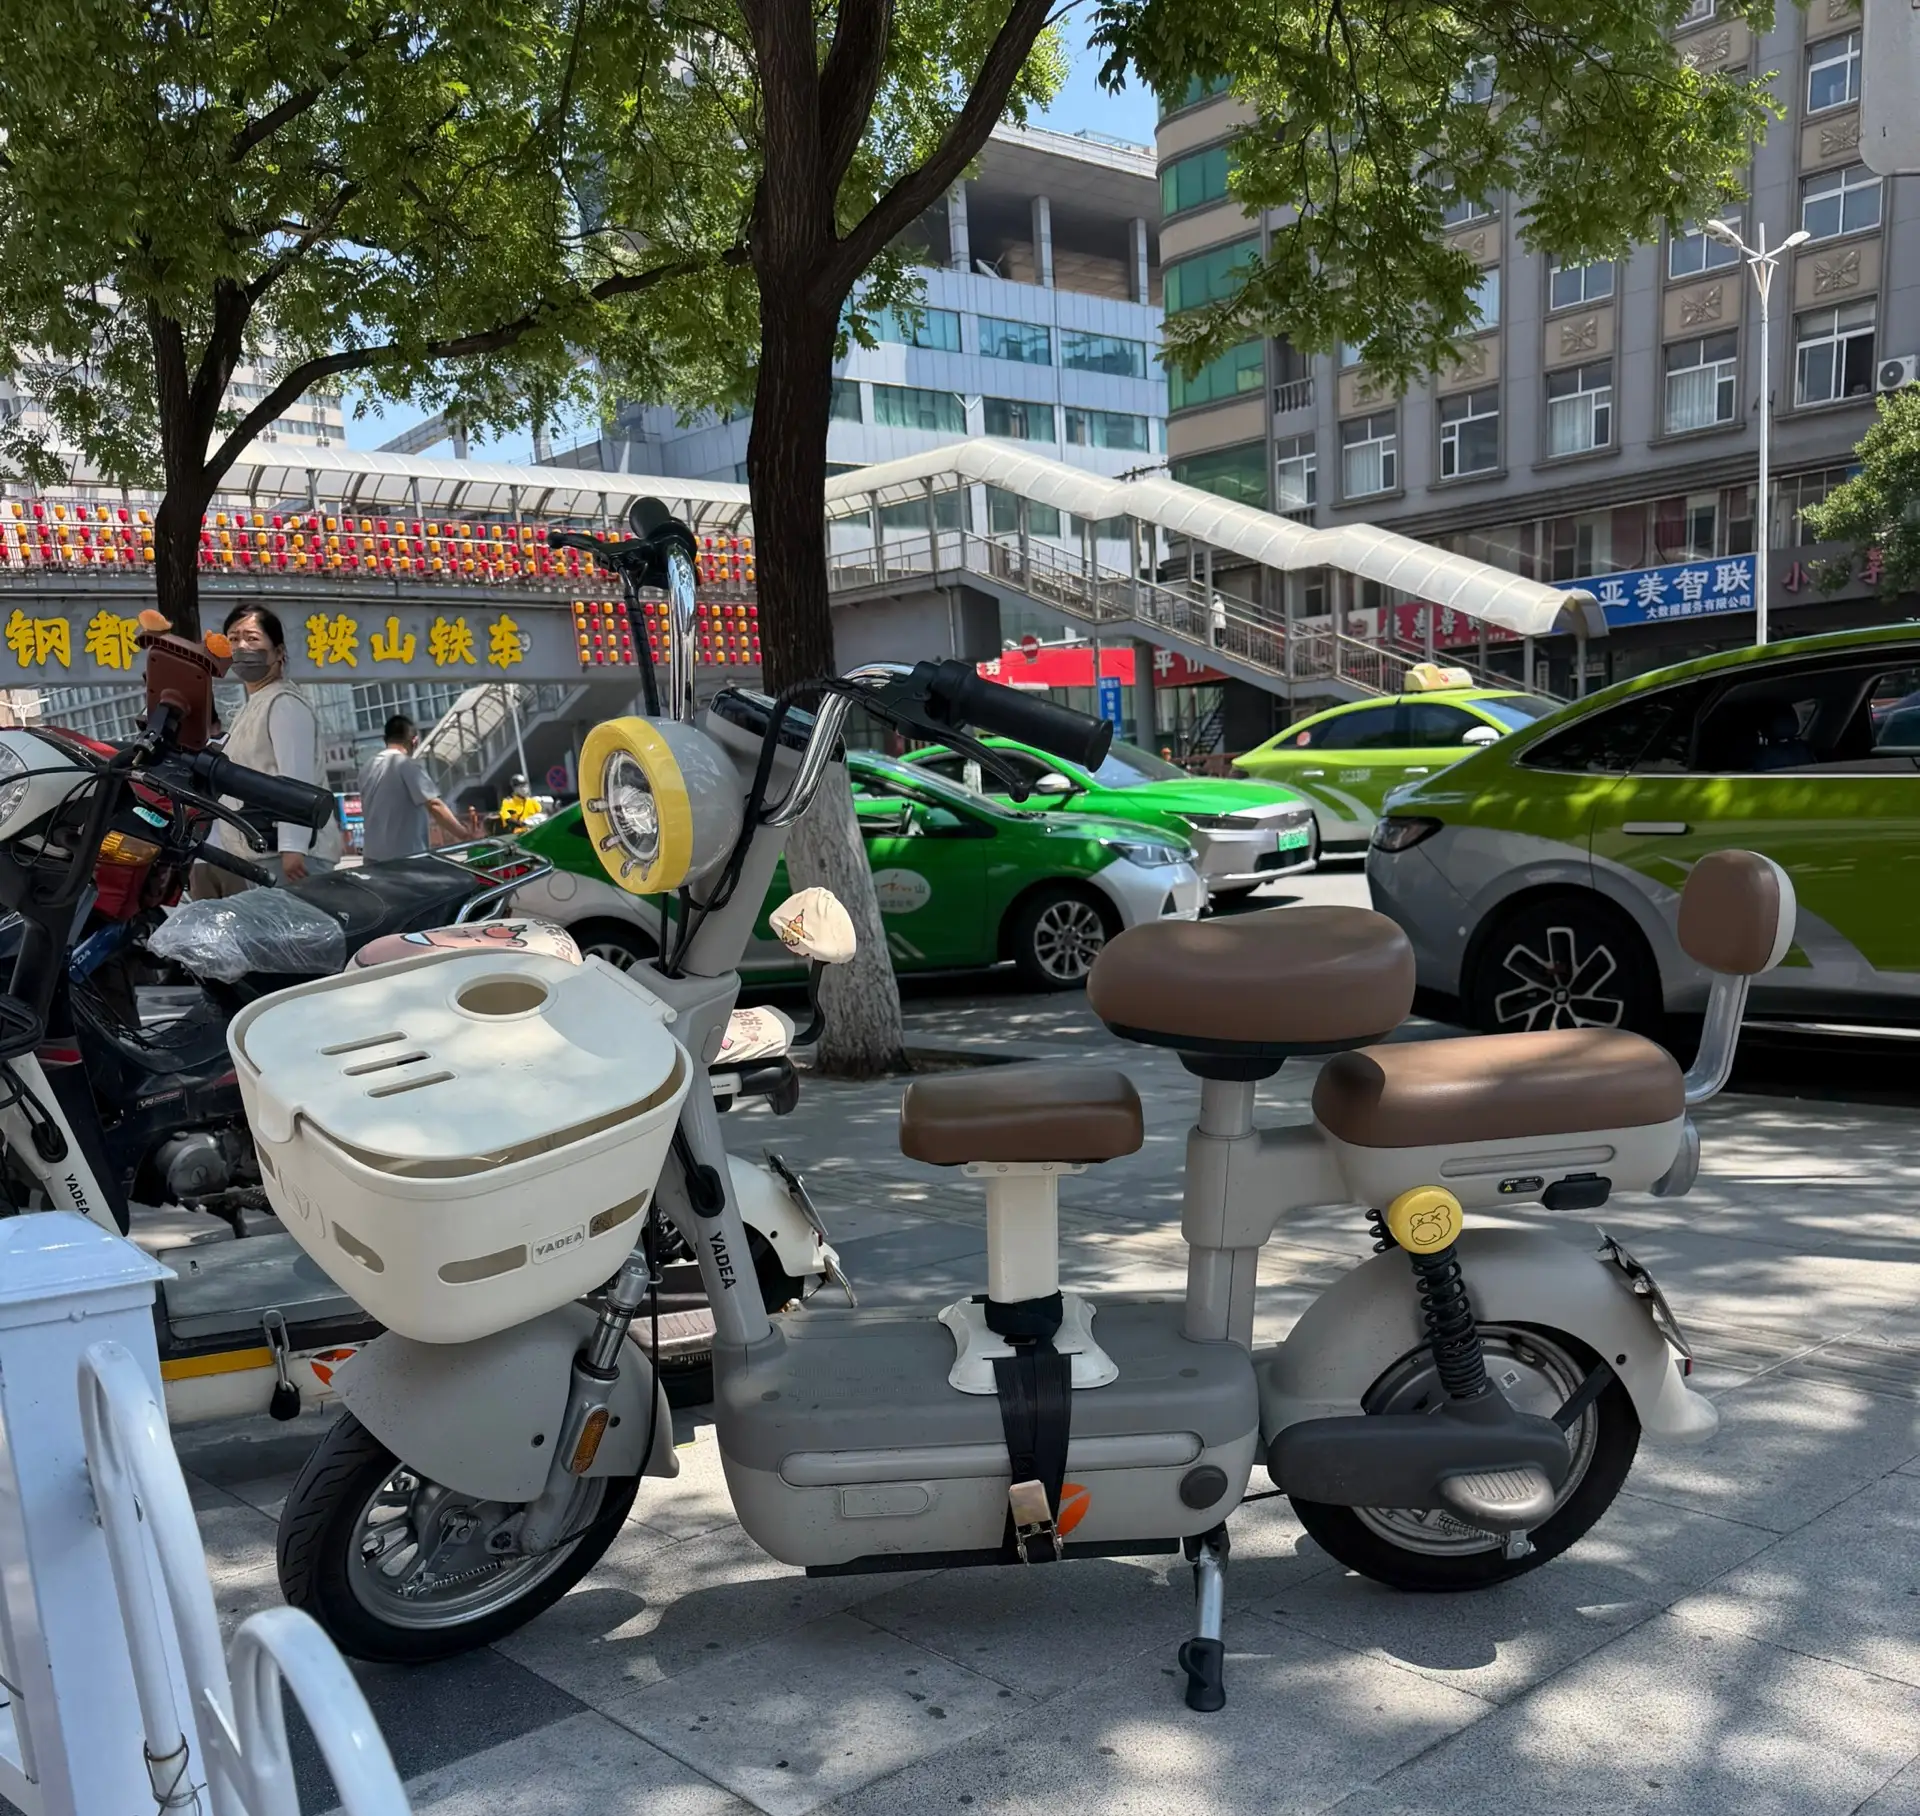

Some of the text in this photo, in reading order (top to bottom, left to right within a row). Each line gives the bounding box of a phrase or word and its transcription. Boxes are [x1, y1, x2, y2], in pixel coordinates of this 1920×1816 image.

[1599, 560, 1752, 608] 亚美智联
[64, 1172, 90, 1215] YADEA
[535, 1230, 583, 1256] YADEA
[709, 1230, 737, 1290] YADEA
